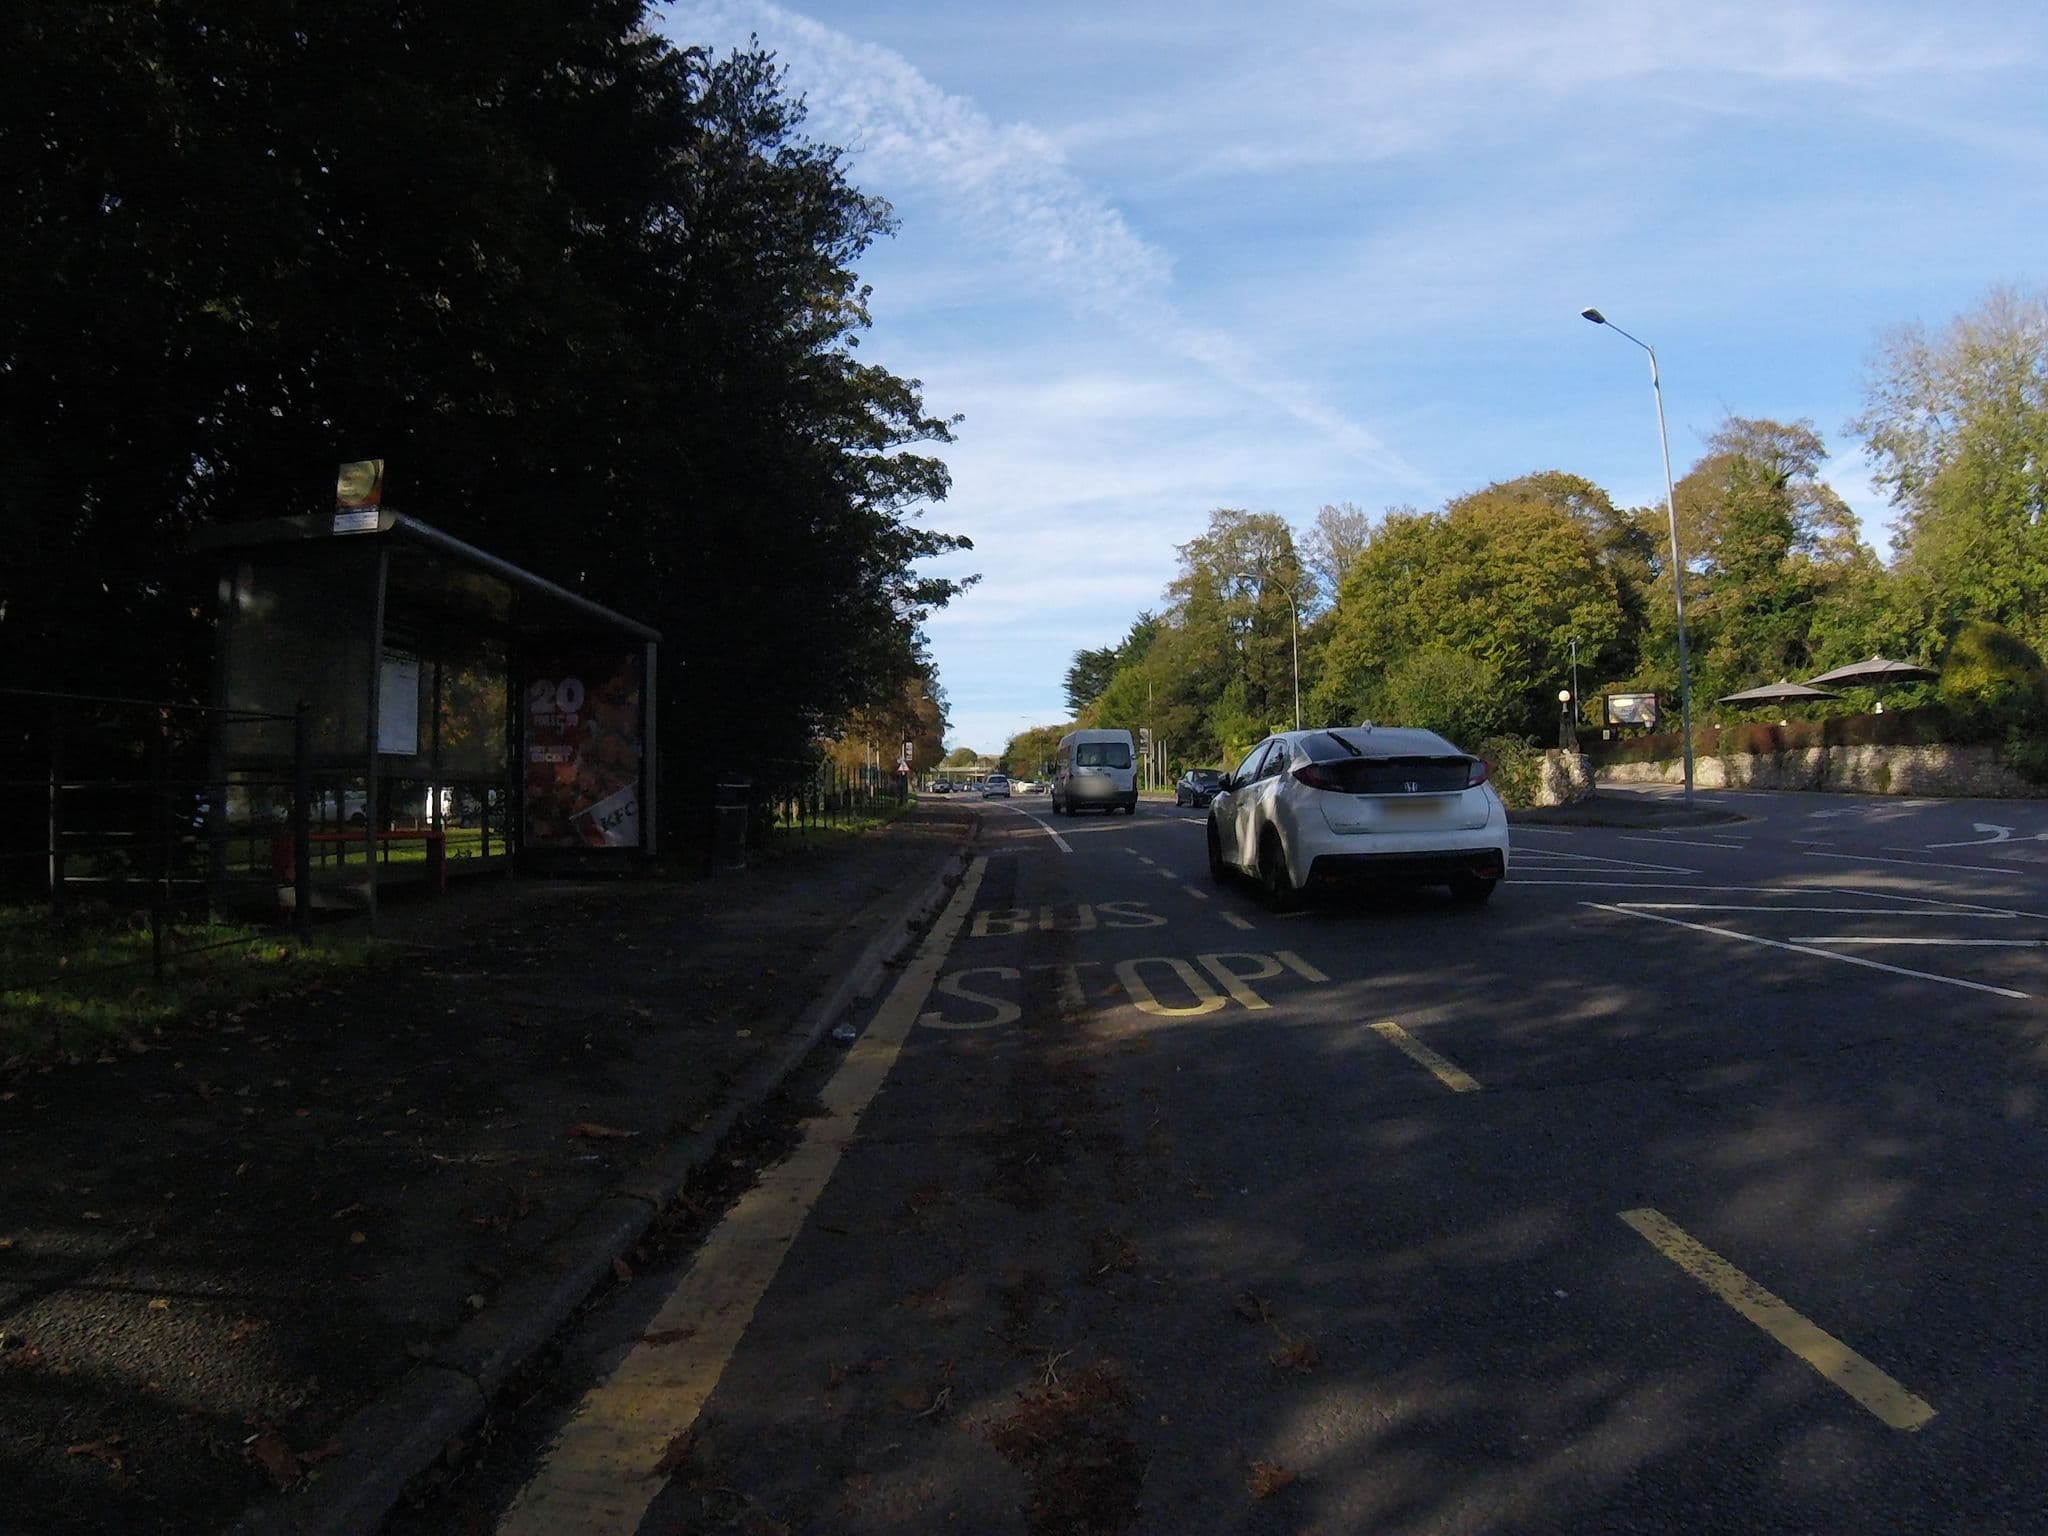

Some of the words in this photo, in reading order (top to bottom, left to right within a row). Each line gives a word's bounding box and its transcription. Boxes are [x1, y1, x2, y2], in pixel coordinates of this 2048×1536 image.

[529, 676, 585, 713] 20
[972, 901, 1168, 937] BUS
[920, 951, 1283, 1030] STOP
